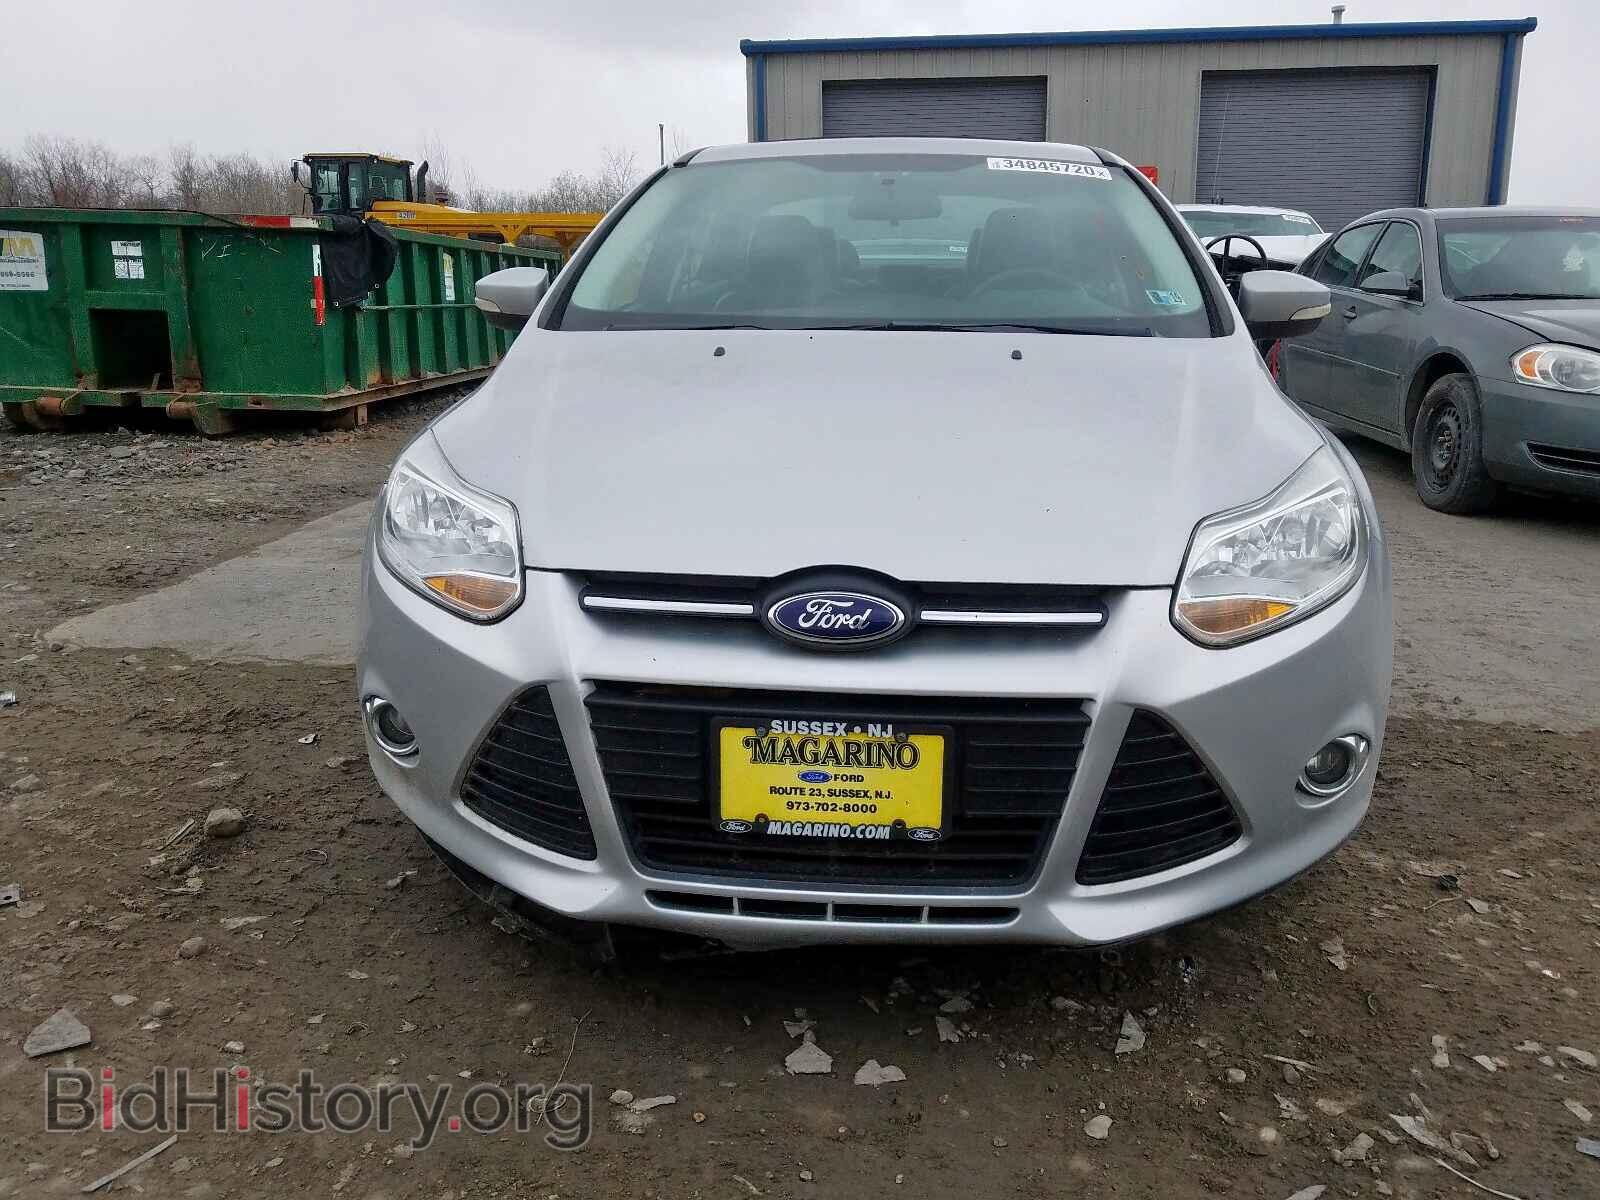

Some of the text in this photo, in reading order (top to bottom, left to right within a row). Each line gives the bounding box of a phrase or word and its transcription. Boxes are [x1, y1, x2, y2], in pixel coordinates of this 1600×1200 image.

[1003, 159, 1096, 176] 34845720
[798, 599, 871, 629] Ford
[770, 719, 893, 738] SUSSEX NJ
[743, 736, 920, 769] MAGARINO
[833, 773, 864, 783] FORD
[769, 786, 893, 800] ROUTE 23, SUSSEX, N.J.
[786, 800, 877, 814] 973-702-8000
[767, 820, 891, 840] MAGARINO.COM
